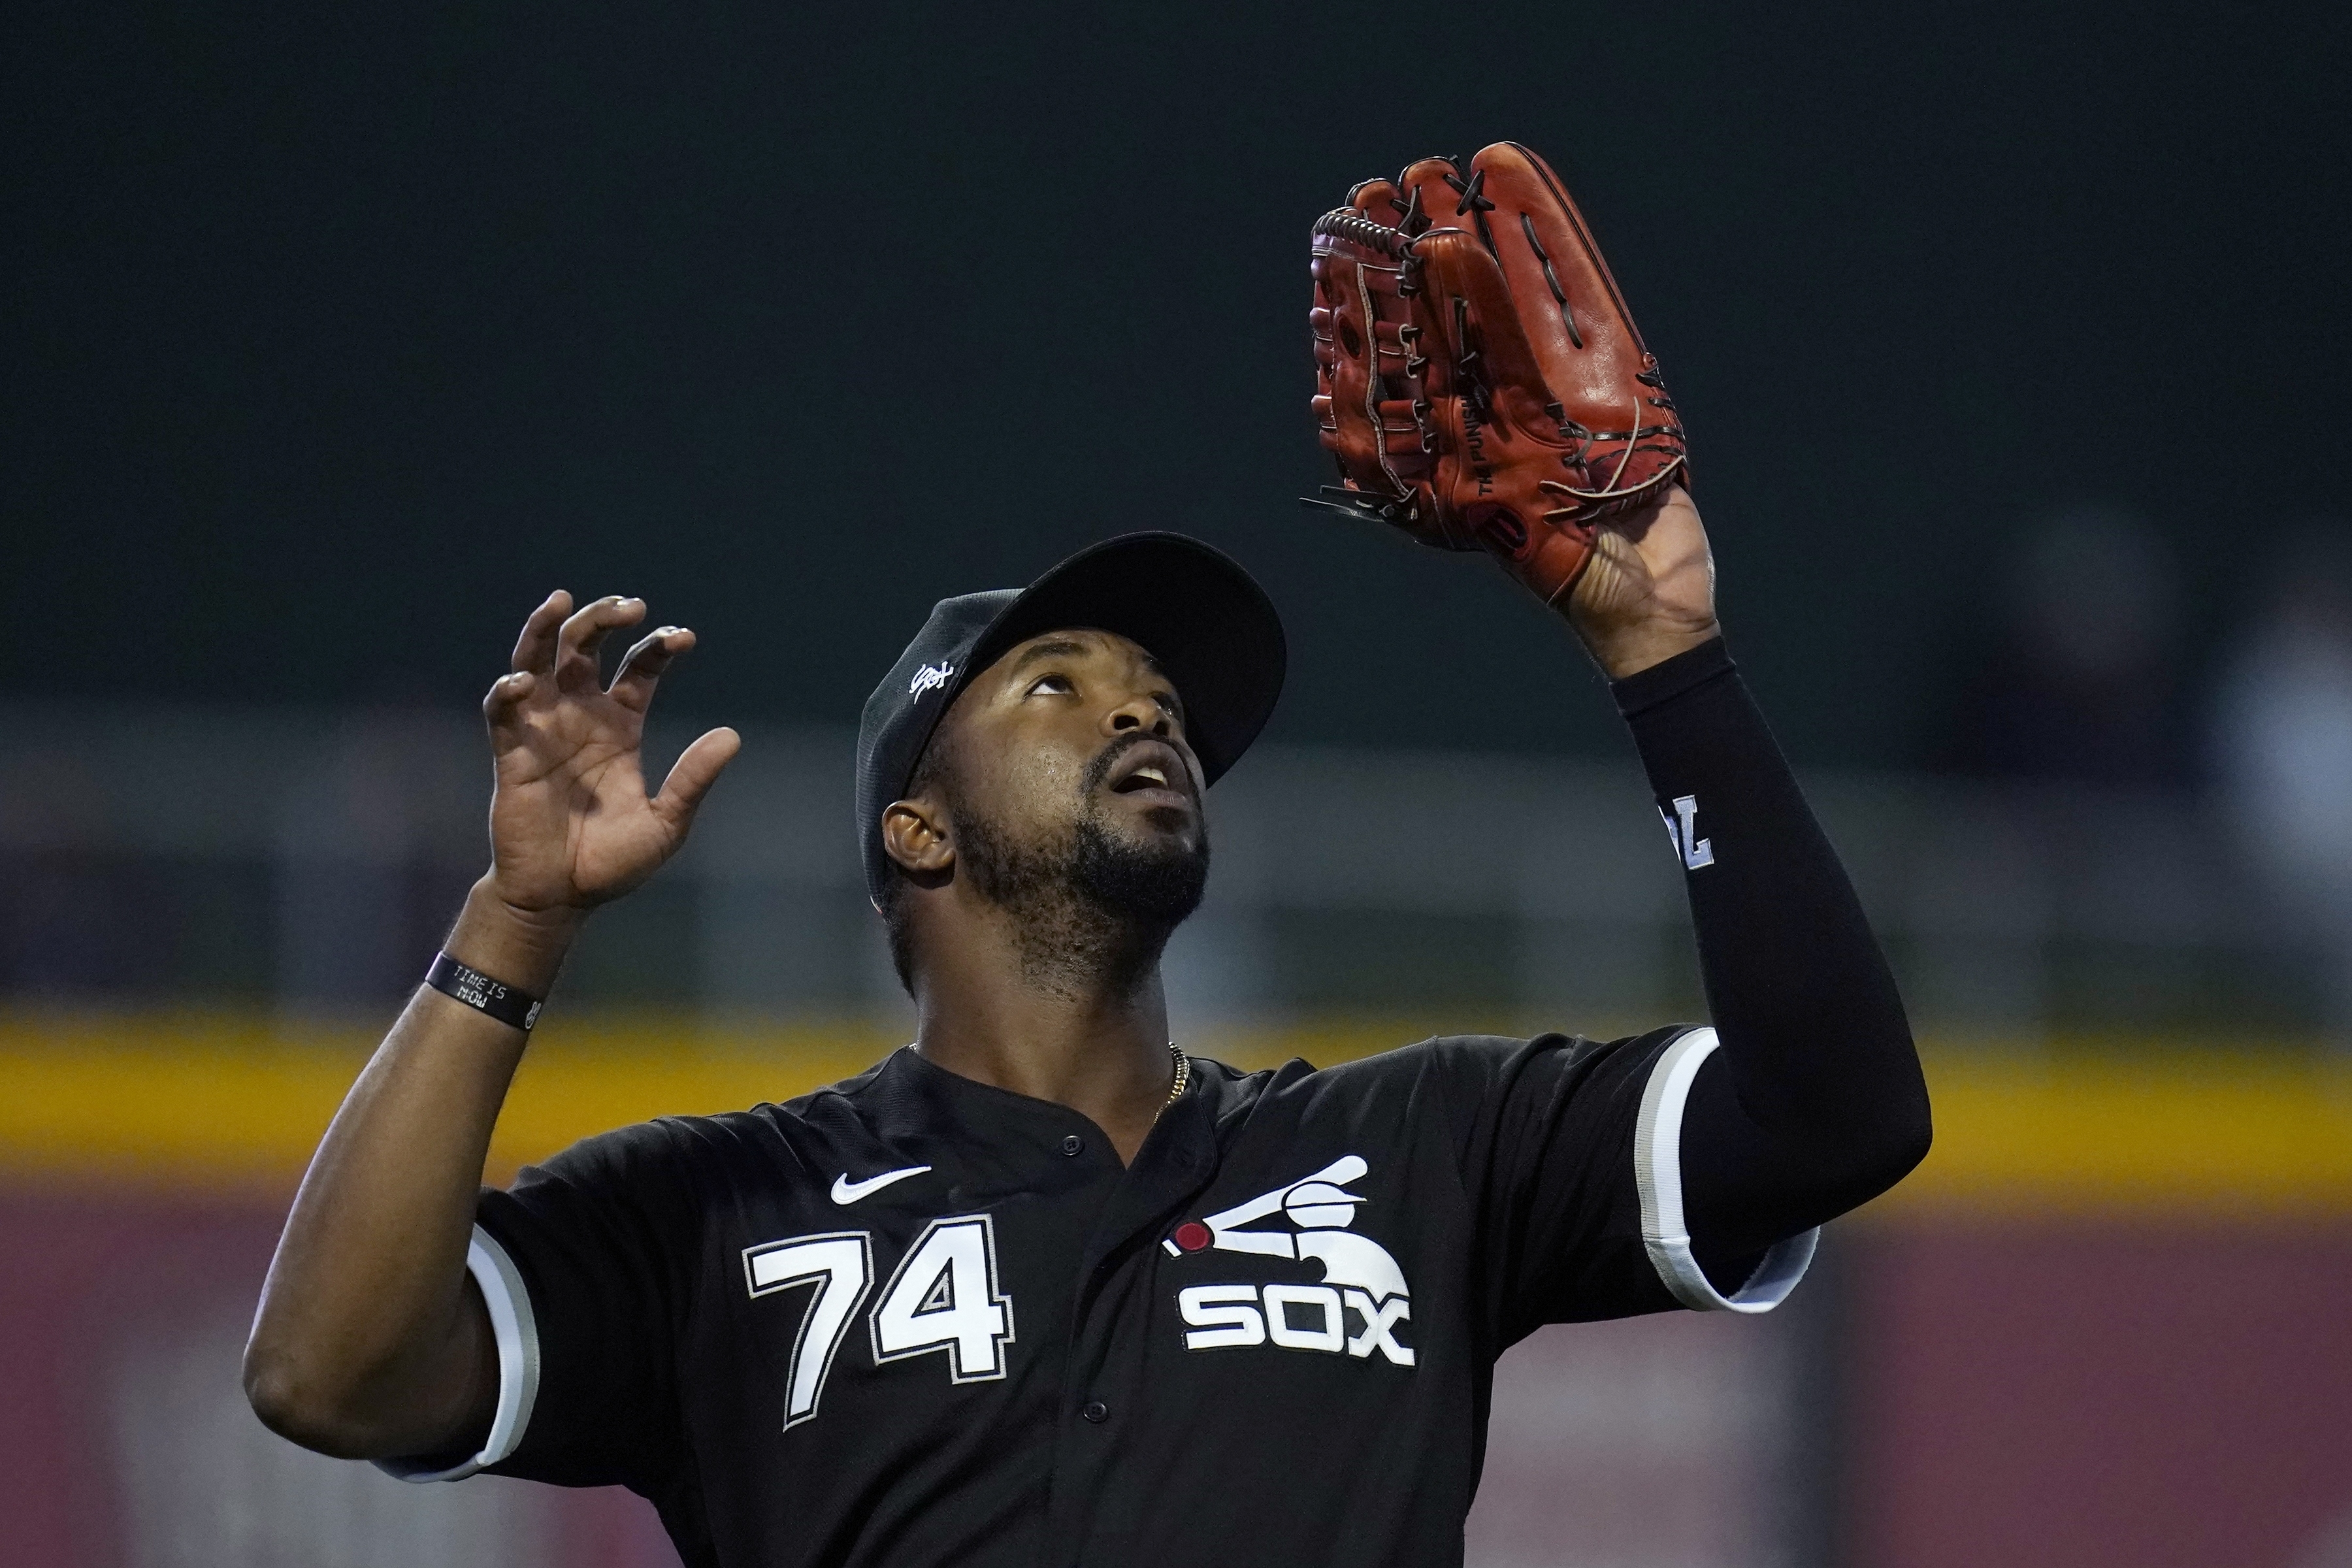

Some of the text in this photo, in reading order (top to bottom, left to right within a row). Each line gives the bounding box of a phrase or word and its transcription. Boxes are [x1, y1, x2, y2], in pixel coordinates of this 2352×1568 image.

[454, 966, 508, 1000] TIME IS
[742, 1213, 1016, 1433] 74
[1179, 1284, 1416, 1367] SOX
